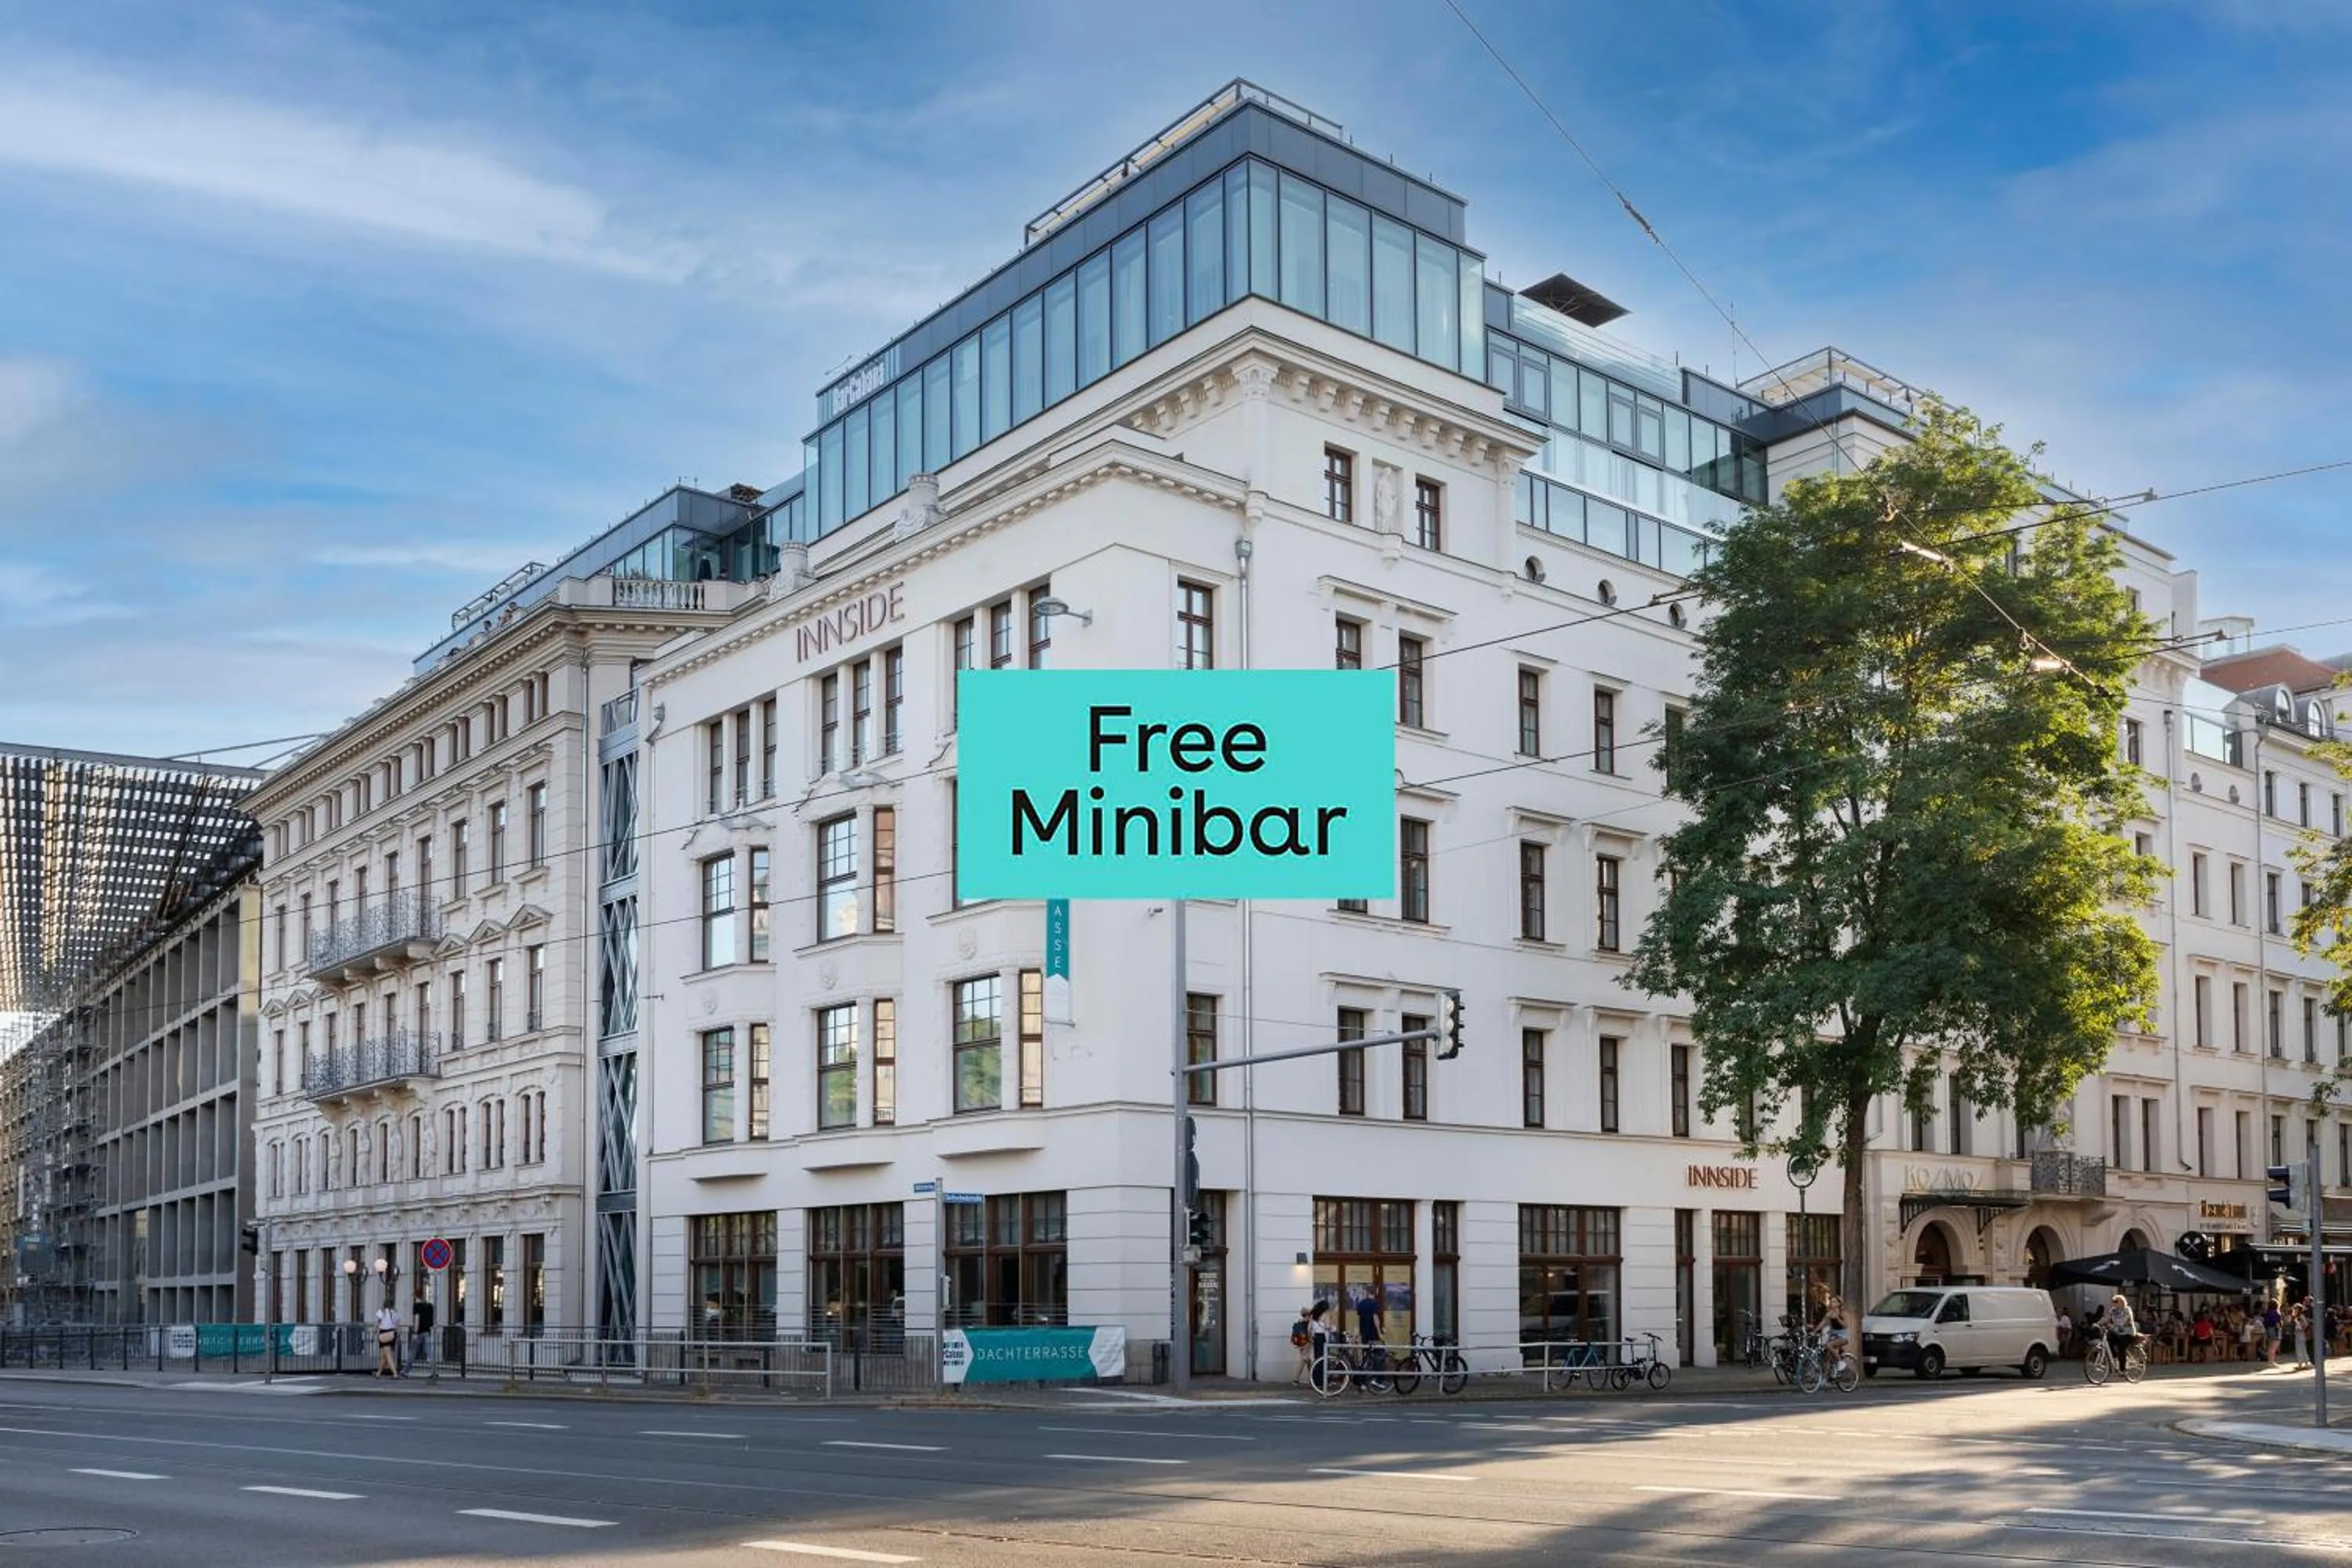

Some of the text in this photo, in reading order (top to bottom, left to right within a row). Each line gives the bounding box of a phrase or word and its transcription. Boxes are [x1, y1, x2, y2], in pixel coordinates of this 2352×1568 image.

[797, 581, 906, 663] INNSIDE
[1687, 1164, 1759, 1190] INNSIDE
[977, 1345, 1085, 1361] DACHTERRASSE
